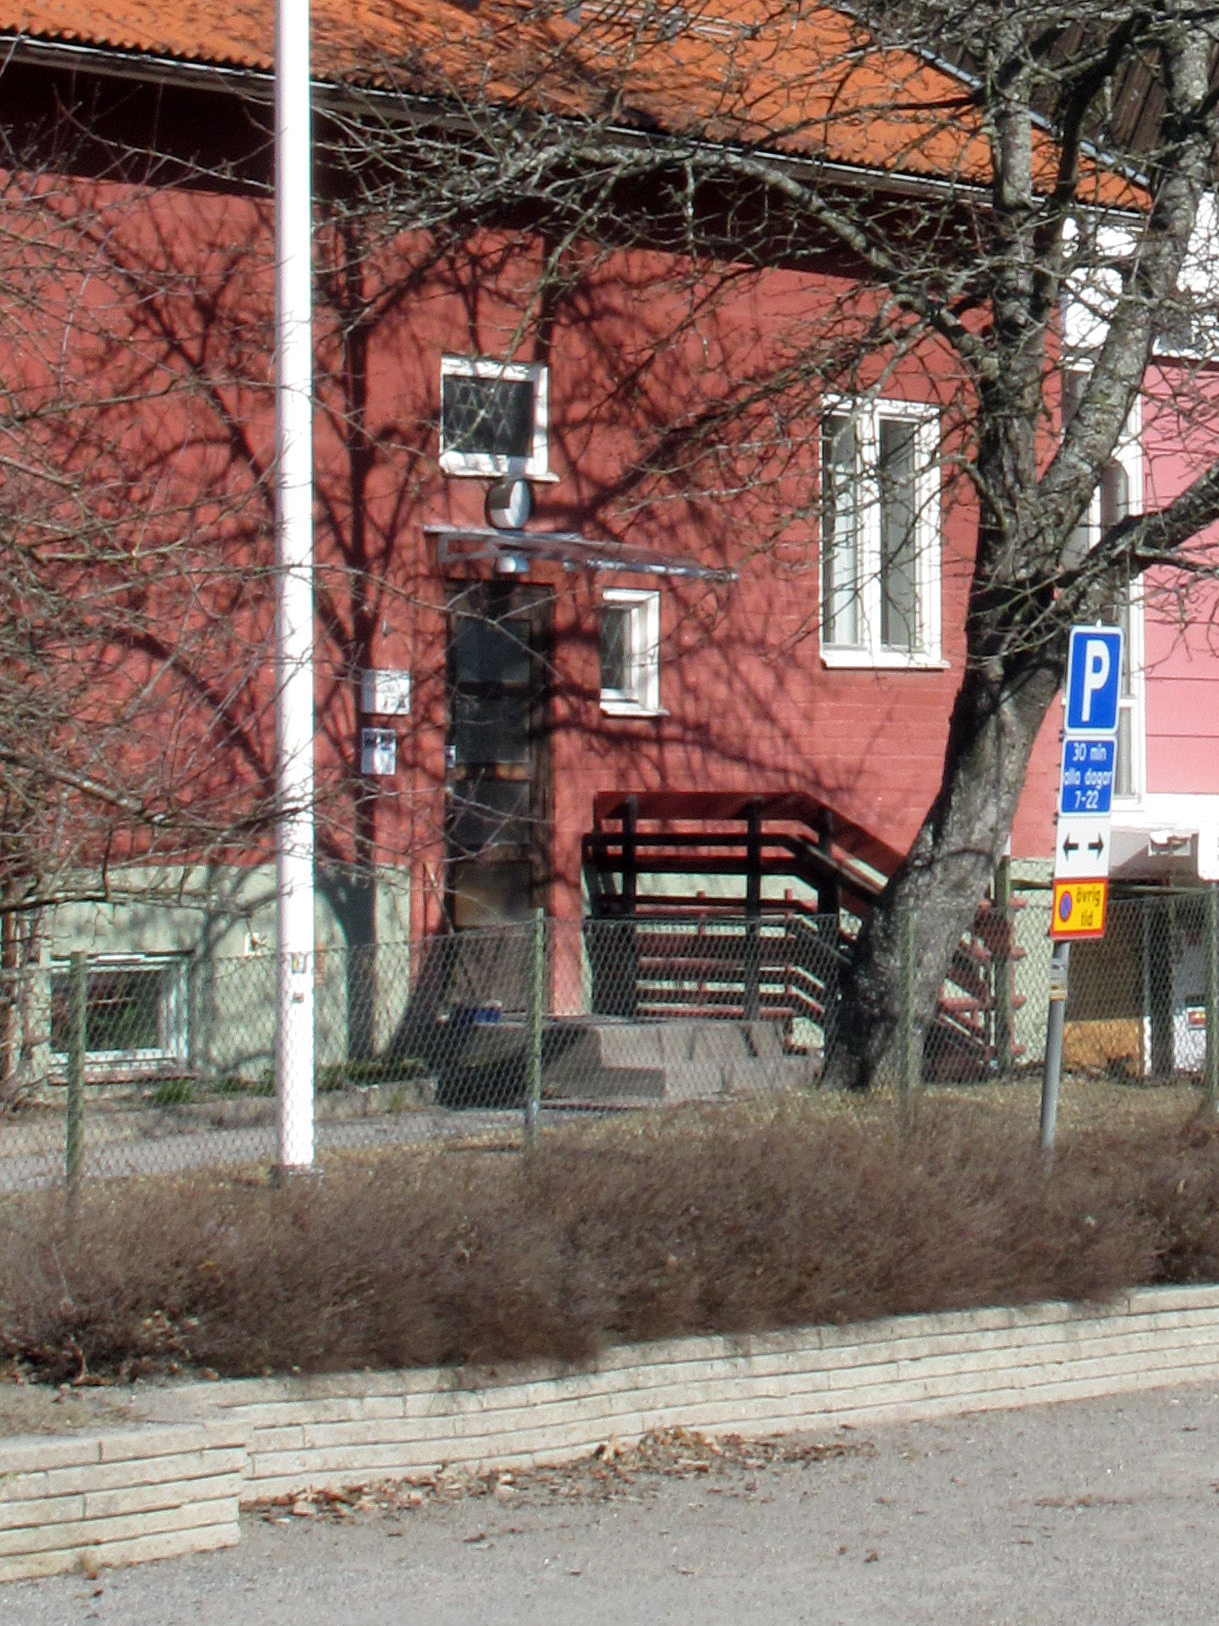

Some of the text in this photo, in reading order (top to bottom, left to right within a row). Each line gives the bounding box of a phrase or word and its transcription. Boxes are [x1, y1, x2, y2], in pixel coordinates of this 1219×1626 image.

[1081, 639, 1111, 723] P
[1073, 742, 1107, 761] 30 min
[1064, 767, 1113, 790] alla dagar
[1075, 790, 1099, 809] 7-22
[1076, 885, 1101, 907] övrig
[1081, 909, 1094, 927] tid
